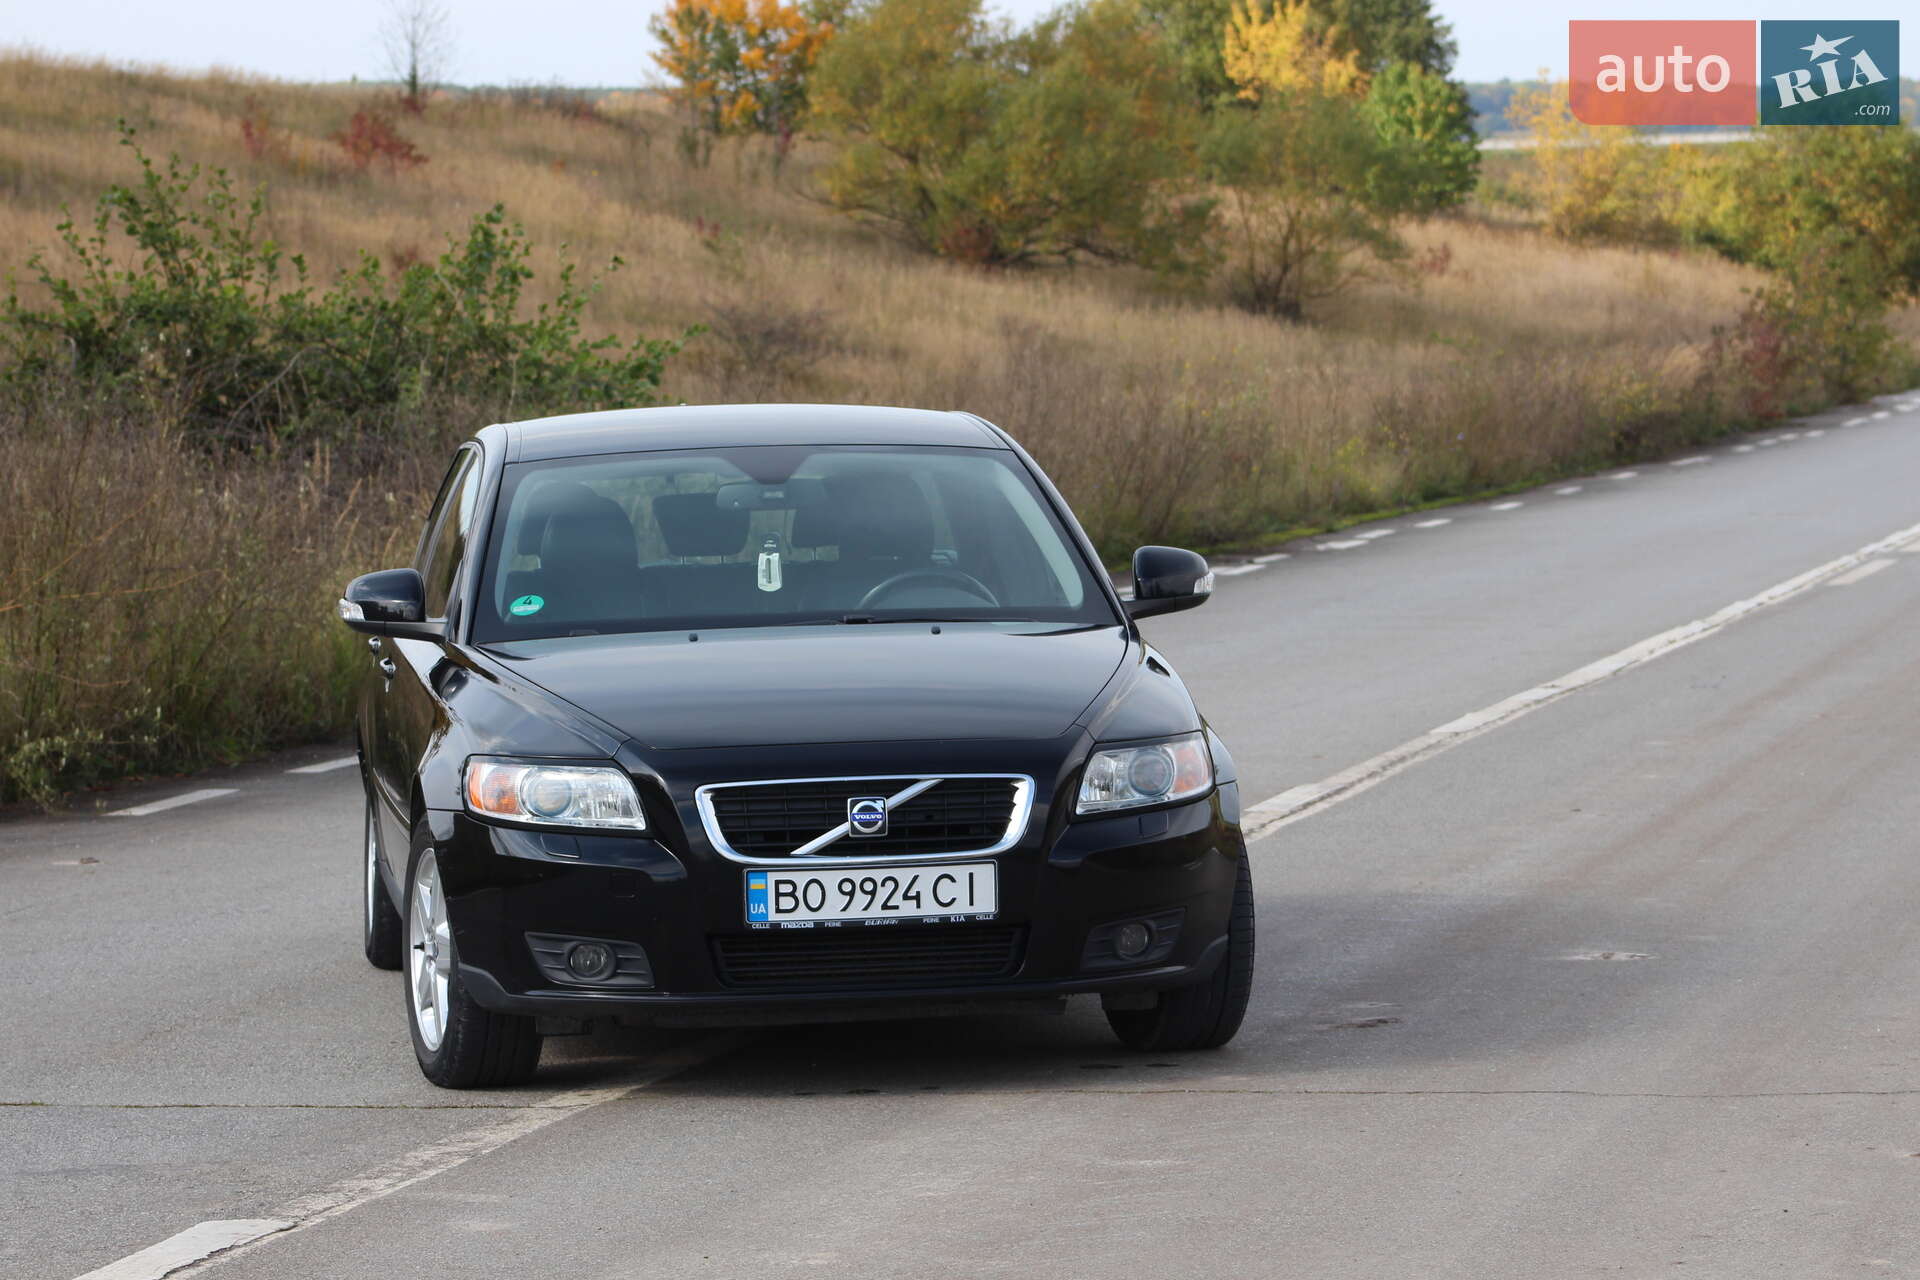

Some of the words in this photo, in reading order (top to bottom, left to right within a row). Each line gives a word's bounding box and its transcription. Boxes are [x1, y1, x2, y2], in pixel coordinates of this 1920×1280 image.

[774, 878, 826, 914] BO
[837, 874, 921, 912] 9924
[932, 872, 975, 908] CI
[750, 903, 767, 914] UA
[950, 914, 966, 923] KIA
